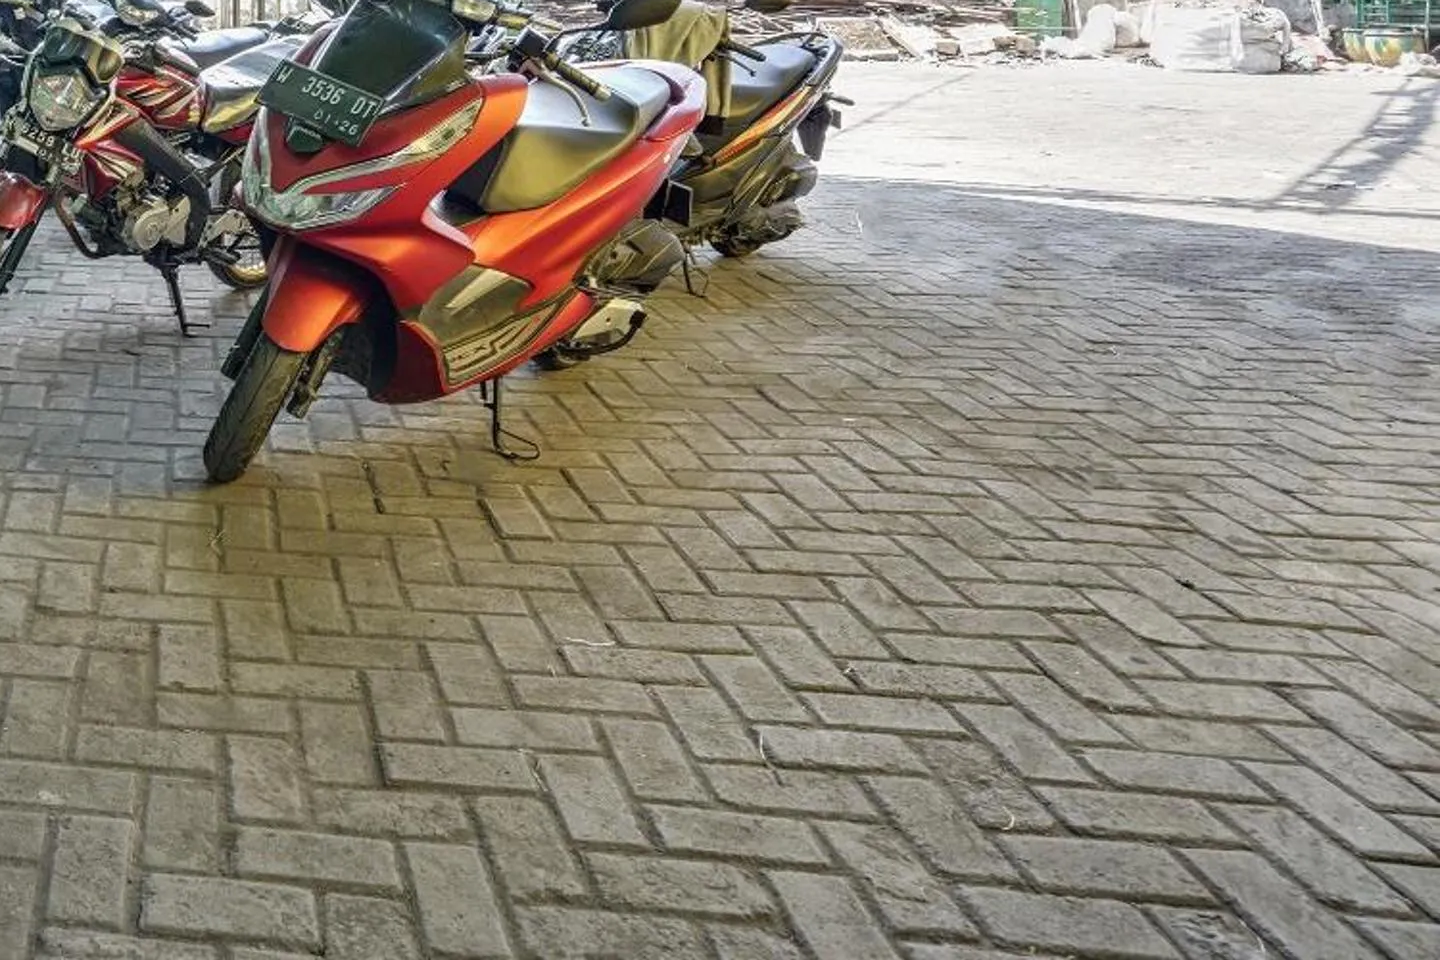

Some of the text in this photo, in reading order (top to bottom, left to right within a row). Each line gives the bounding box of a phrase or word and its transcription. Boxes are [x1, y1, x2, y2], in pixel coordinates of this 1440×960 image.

[276, 66, 377, 118] W 3536 DT
